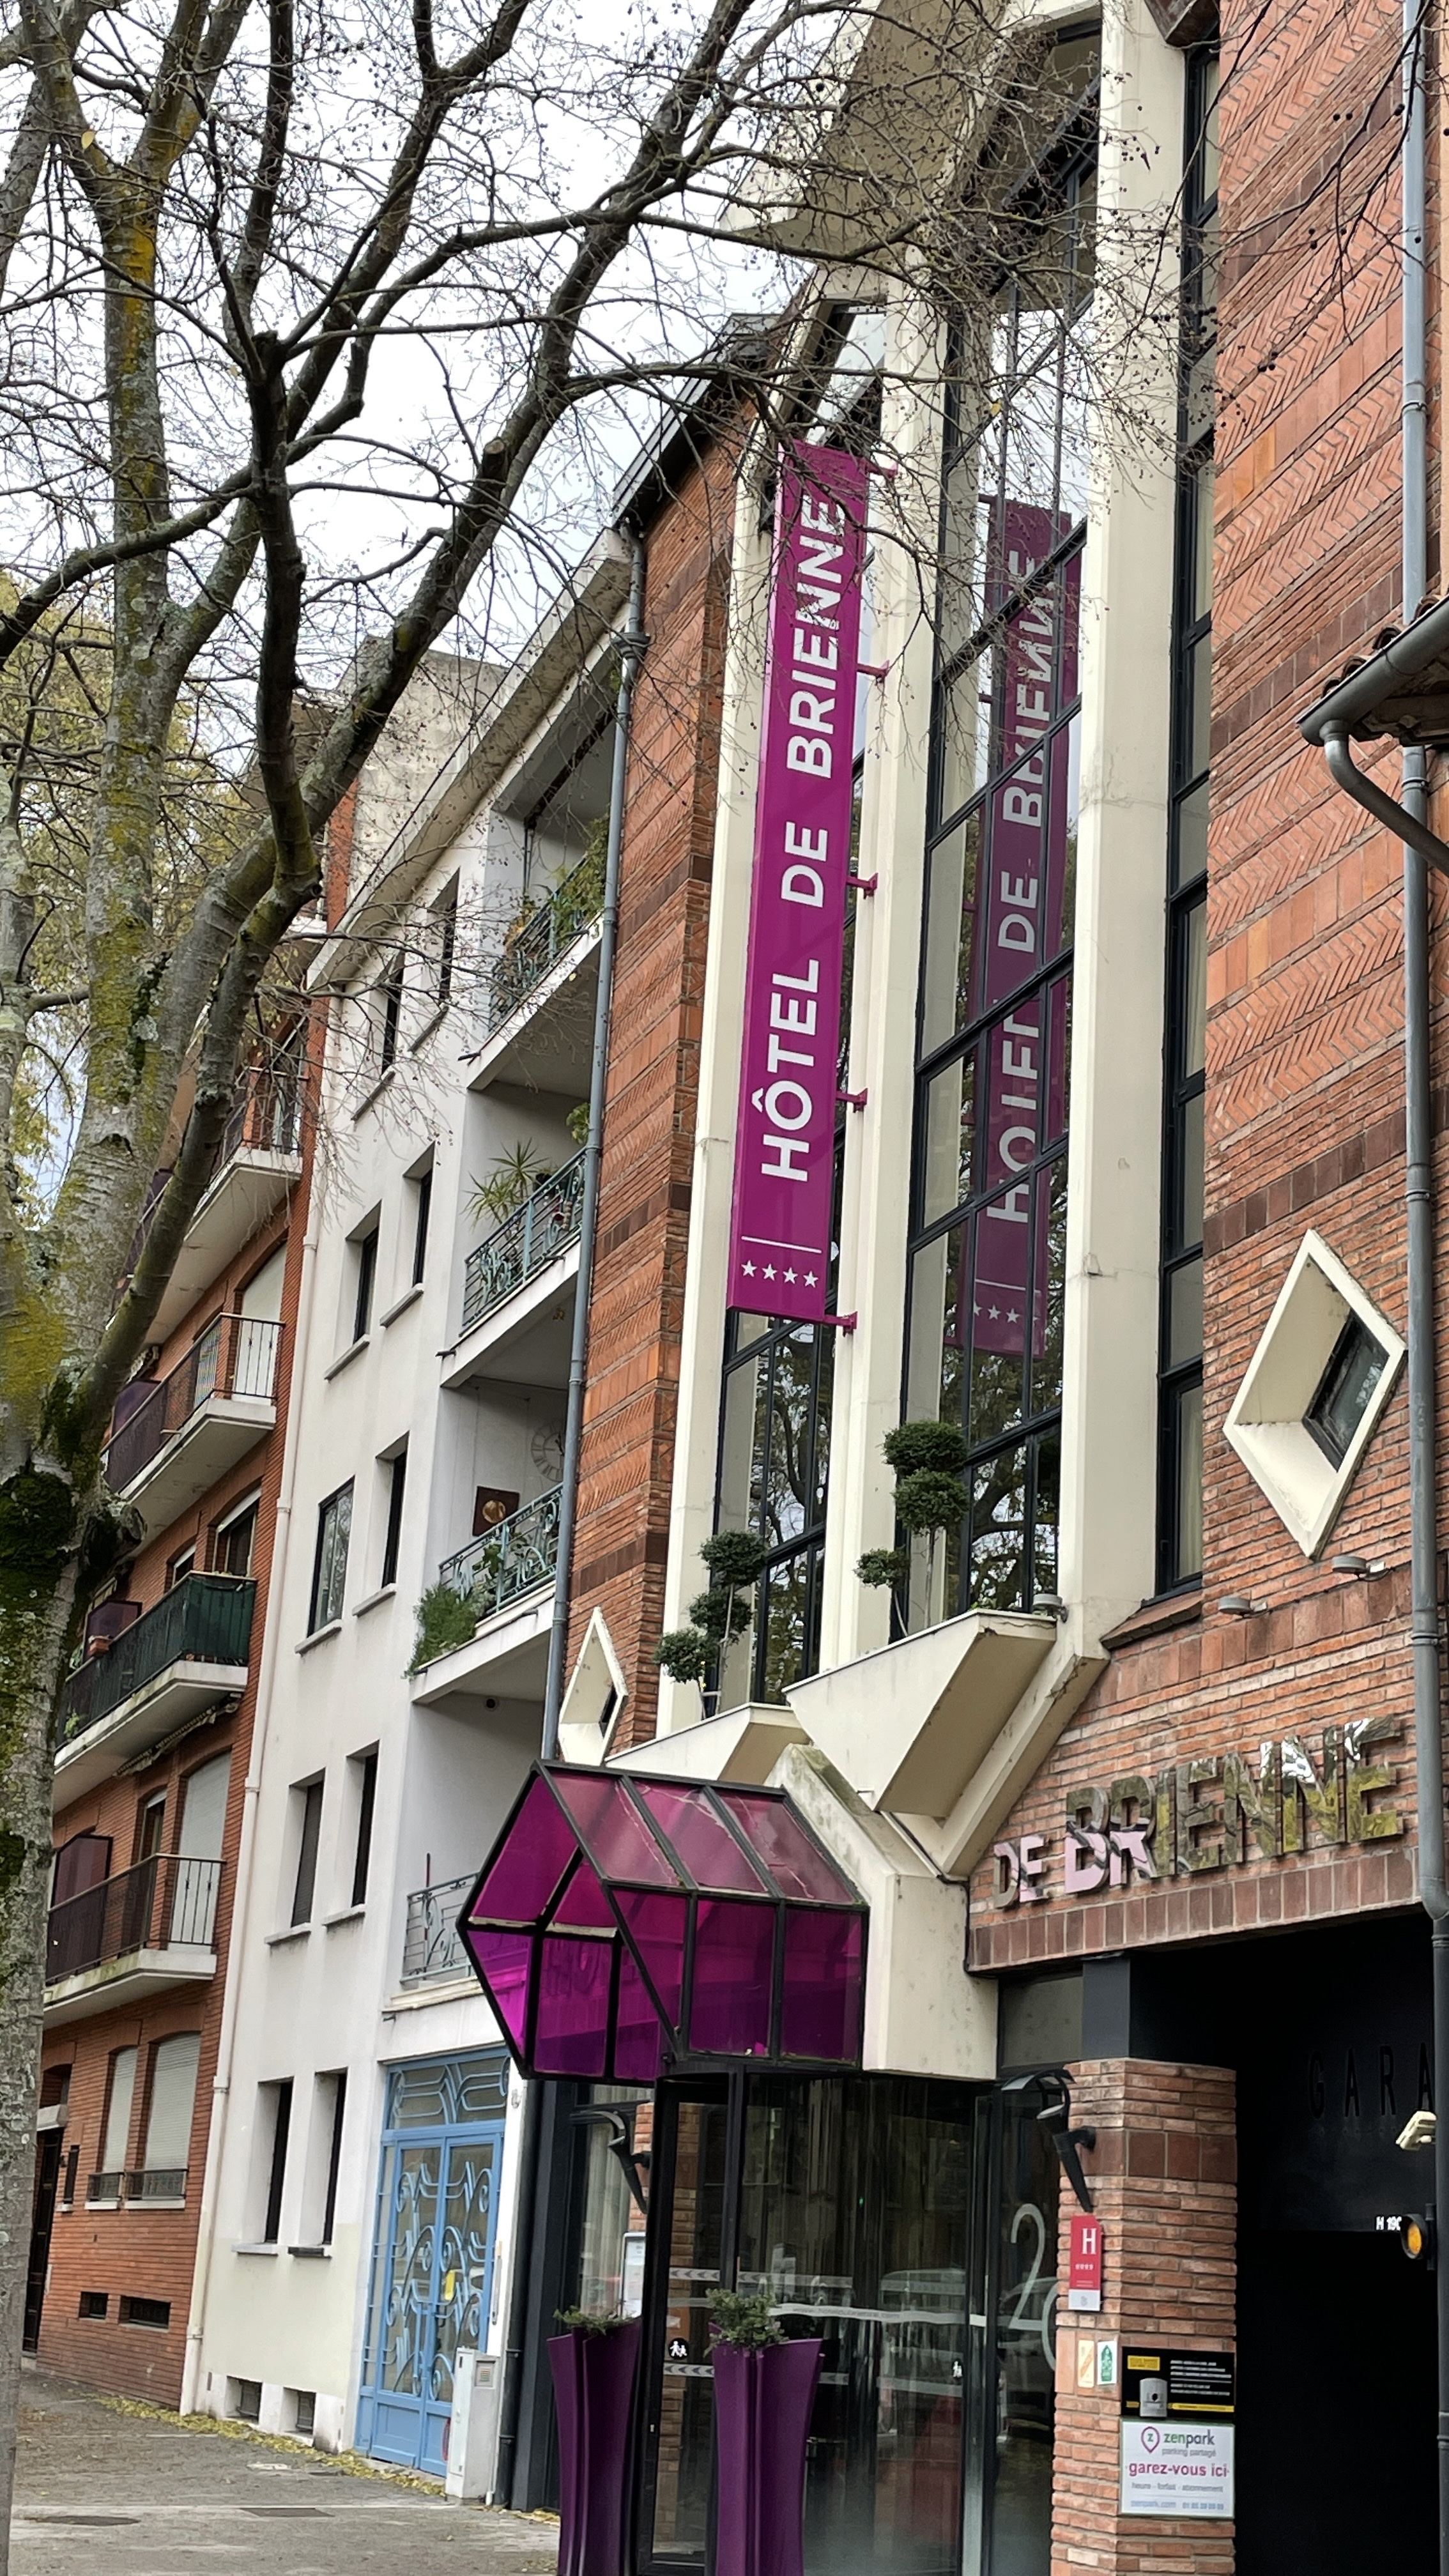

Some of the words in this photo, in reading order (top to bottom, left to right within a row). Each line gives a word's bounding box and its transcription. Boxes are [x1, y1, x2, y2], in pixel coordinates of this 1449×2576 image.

[786, 494, 846, 779] BRIENNE
[781, 822, 829, 908] DE
[751, 958, 820, 1182] HÔTEL
[992, 1834, 1048, 1908] DE
[1064, 1715, 1404, 1894] BRIENNE
[1082, 2227, 1096, 2255] H
[1162, 2448, 1188, 2457] parking
[1163, 2429, 1215, 2448] zenpark
[1129, 2462, 1207, 2476] garez-vous
[1211, 2463, 1228, 2477] ici
